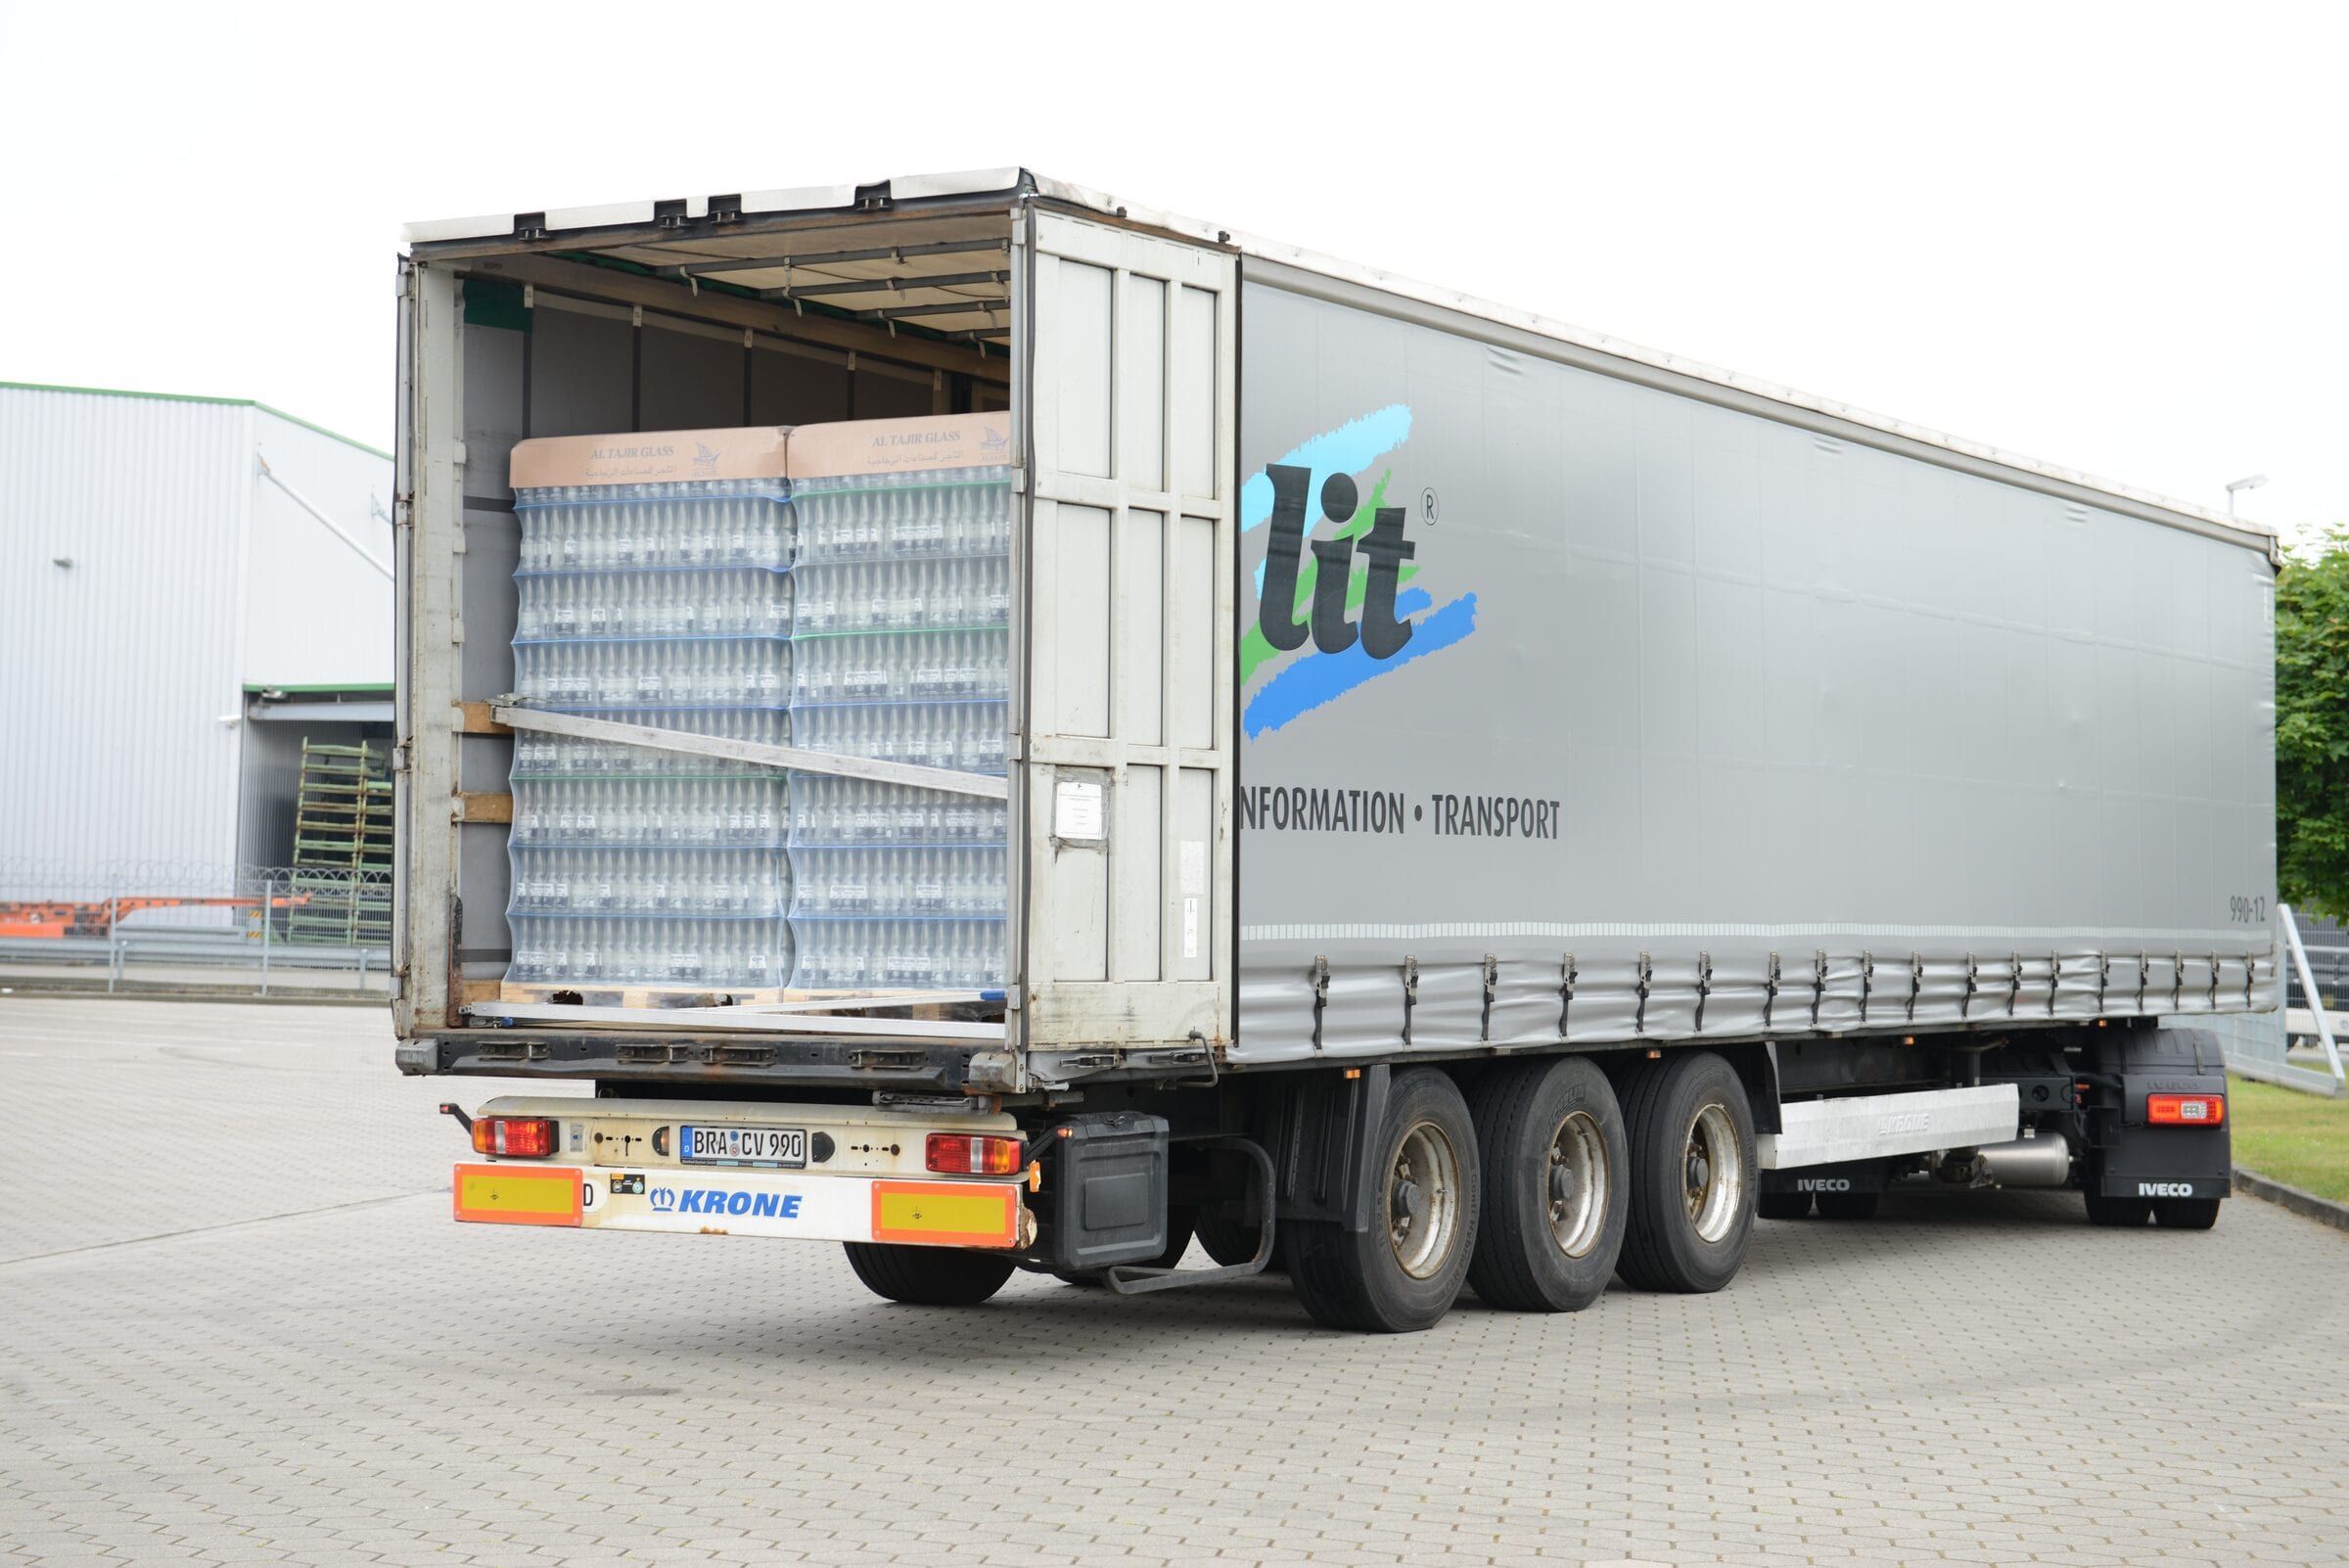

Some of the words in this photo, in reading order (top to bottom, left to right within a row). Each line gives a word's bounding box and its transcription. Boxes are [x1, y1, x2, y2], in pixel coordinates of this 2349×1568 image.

[872, 437, 887, 446] AL
[891, 434, 922, 445] TAJIR
[925, 431, 960, 443] GLASS
[591, 449, 605, 459] AL
[608, 447, 638, 458] TAJIR
[640, 445, 673, 457] GLASS
[1259, 463, 1416, 661] lit
[1432, 794, 1560, 840] TRANSPORT
[2230, 895, 2266, 924] 990-12
[694, 1130, 727, 1154] BRA
[742, 1132, 764, 1156] CV
[769, 1133, 801, 1157] 990
[583, 1183, 594, 1207] D
[1797, 1178, 1851, 1191] IVECO
[2138, 1182, 2193, 1197] IVECO
[678, 1189, 803, 1219] KRONE
